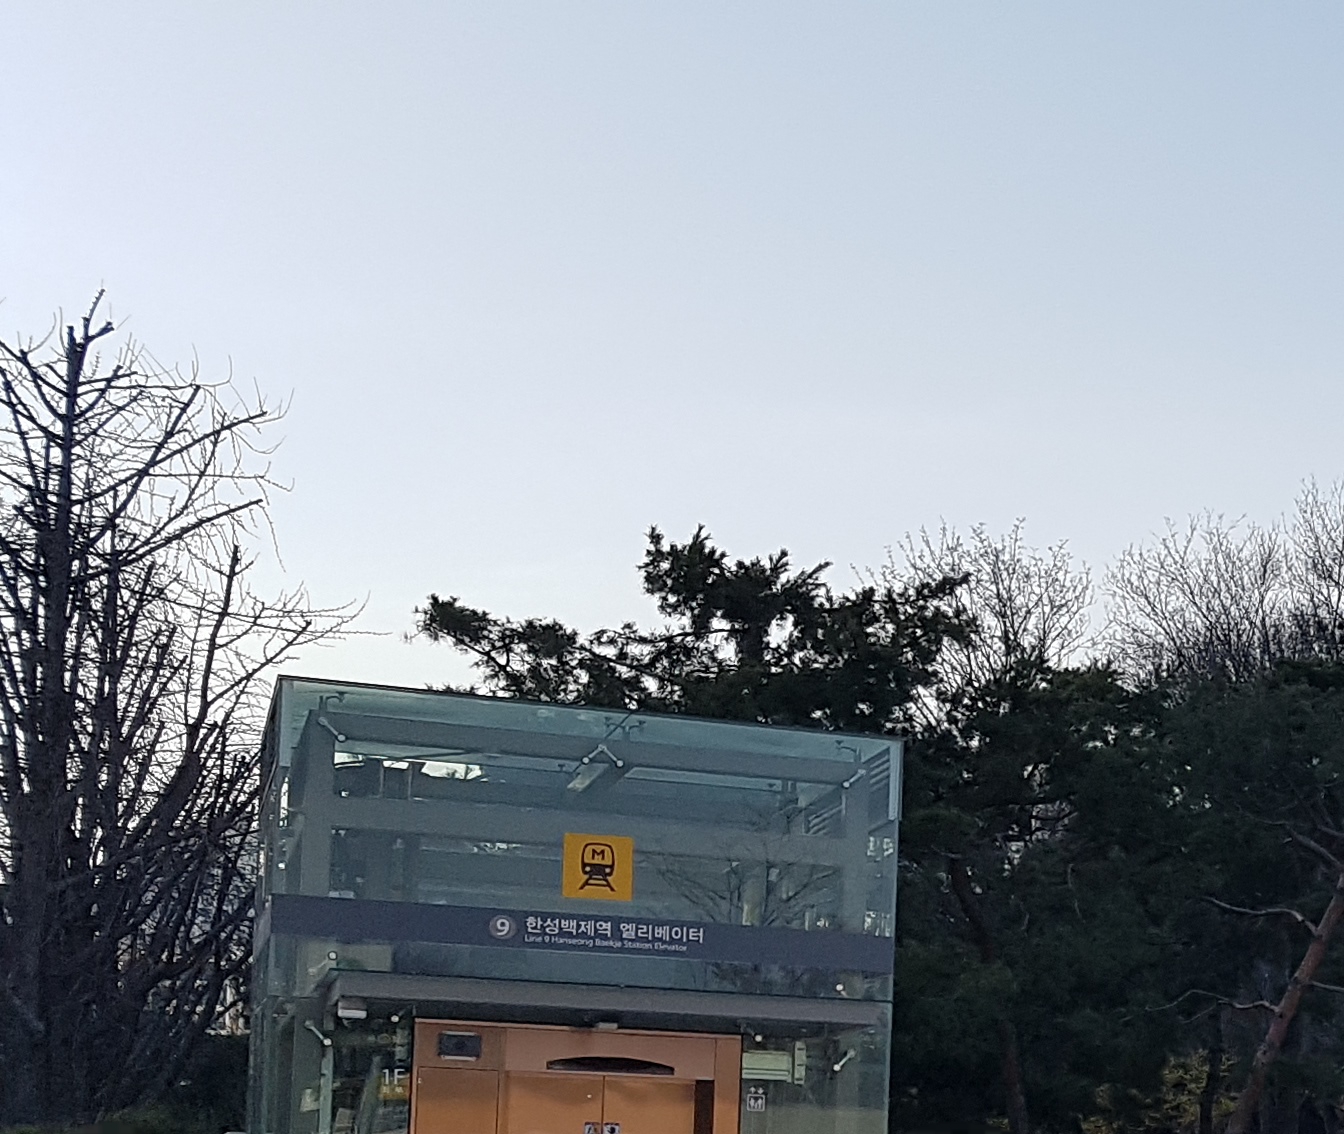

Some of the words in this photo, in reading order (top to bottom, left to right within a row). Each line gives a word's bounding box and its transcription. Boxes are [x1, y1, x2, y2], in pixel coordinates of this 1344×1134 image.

[592, 848, 605, 860] M
[496, 919, 510, 936] 9
[526, 916, 611, 937] 한성백제역
[620, 922, 704, 943] 엘리베이터
[524, 934, 542, 943] Line
[552, 937, 593, 947] Hanseong
[624, 940, 652, 949] Station
[655, 942, 688, 951] Elevator
